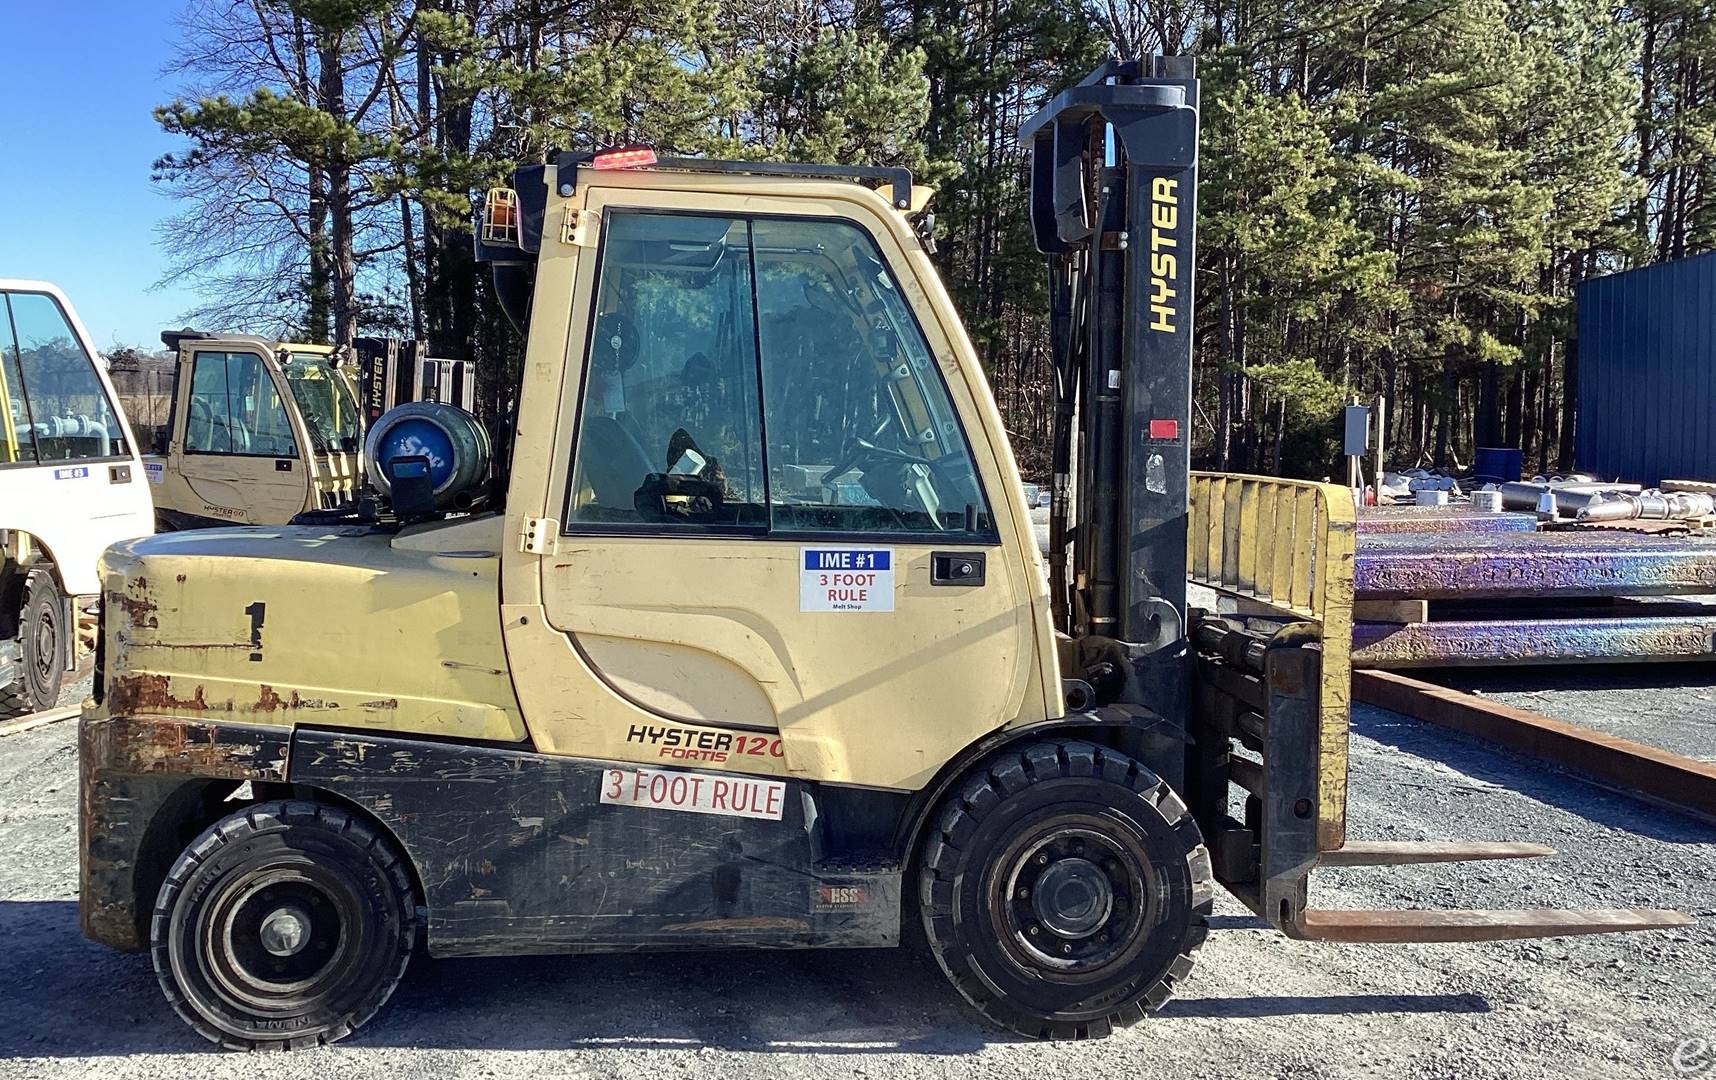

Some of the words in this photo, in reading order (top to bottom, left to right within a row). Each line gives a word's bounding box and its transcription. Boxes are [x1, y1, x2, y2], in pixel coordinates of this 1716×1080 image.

[1150, 175, 1178, 333] HYSTER
[372, 356, 384, 408] HYSTER
[819, 552, 850, 568] IME
[855, 553, 874, 568] #1
[820, 574, 828, 586] 3
[833, 574, 876, 586] FOOT
[828, 589, 867, 601] RULE
[847, 603, 862, 611] Shop
[626, 724, 733, 751] HYSTER
[659, 747, 728, 763] FORTIS
[606, 768, 624, 800] 3
[633, 769, 705, 807] FOOT
[711, 780, 781, 815] RULE
[831, 888, 858, 903] HSS
